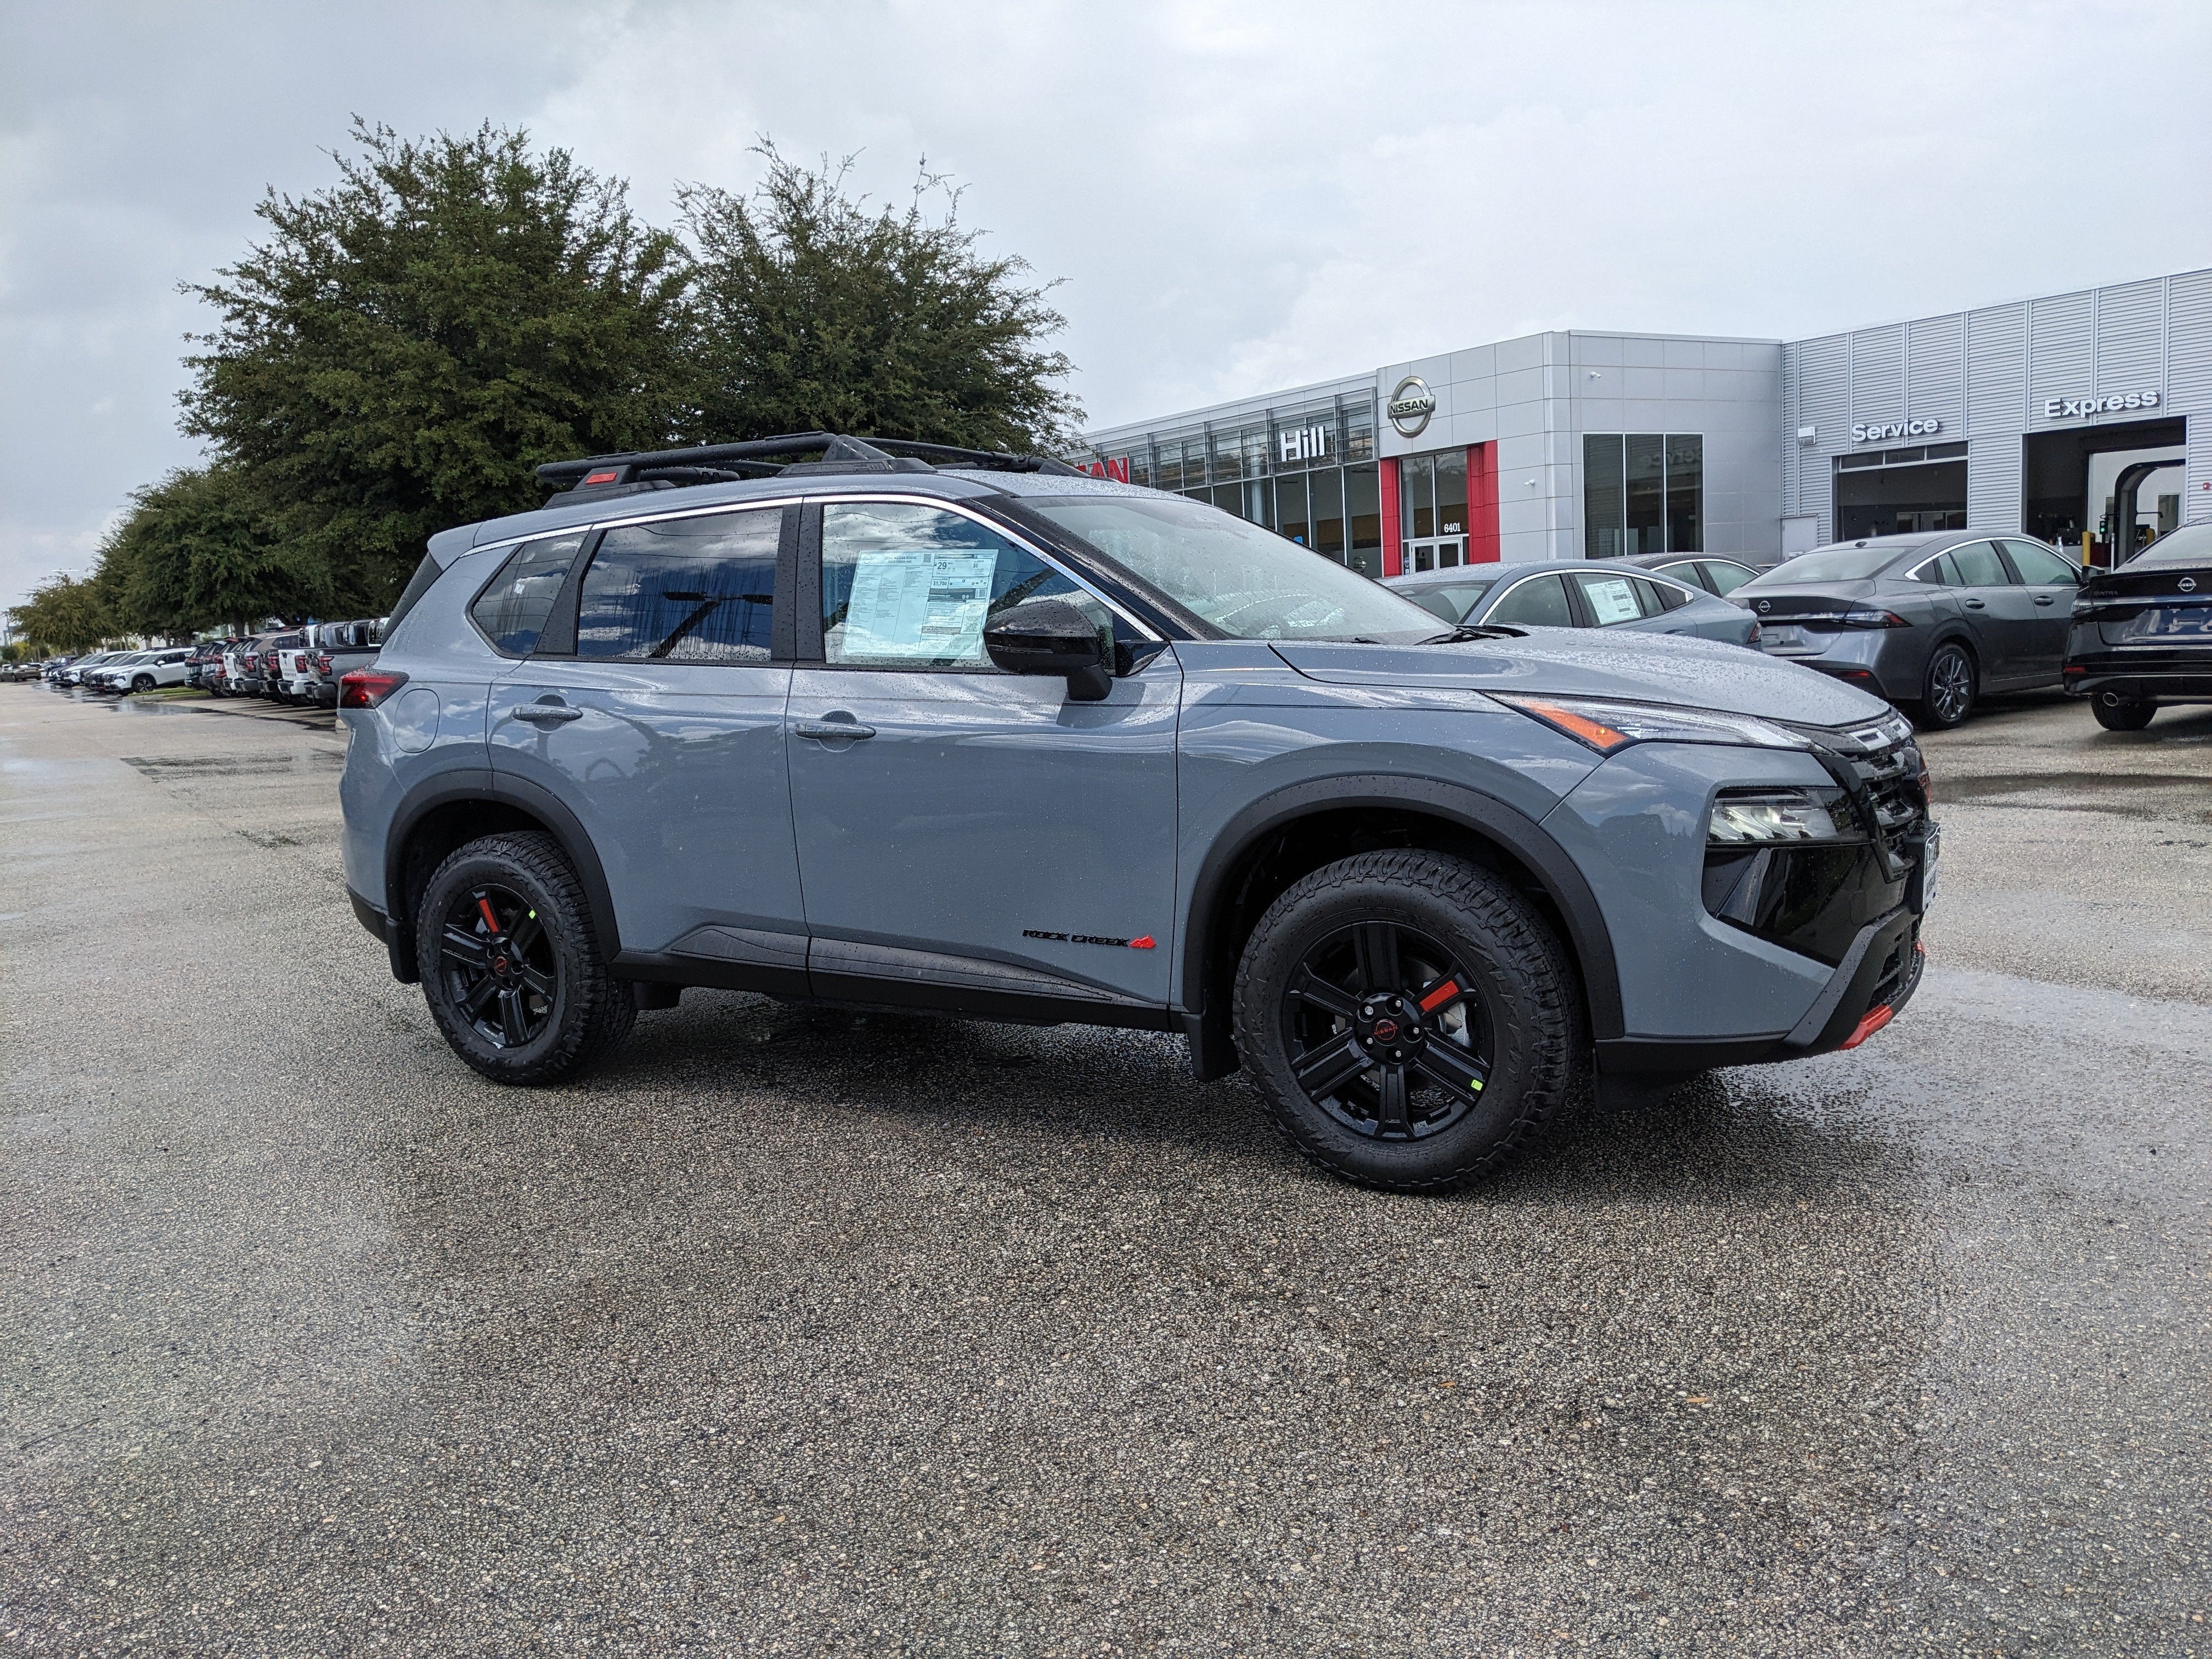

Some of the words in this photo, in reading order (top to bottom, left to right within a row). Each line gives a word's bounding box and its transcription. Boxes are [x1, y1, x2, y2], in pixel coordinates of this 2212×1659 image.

[1390, 399, 1429, 415] NISSAN
[2044, 391, 2158, 418] Express
[1851, 419, 1939, 442] Service
[1281, 426, 1325, 462] Hill
[1444, 522, 1460, 533] 6401
[937, 562, 947, 570] 29
[1022, 929, 1069, 941] ROCK
[1070, 934, 1130, 947] CREEK
[1374, 1025, 1398, 1035] NISSAN
